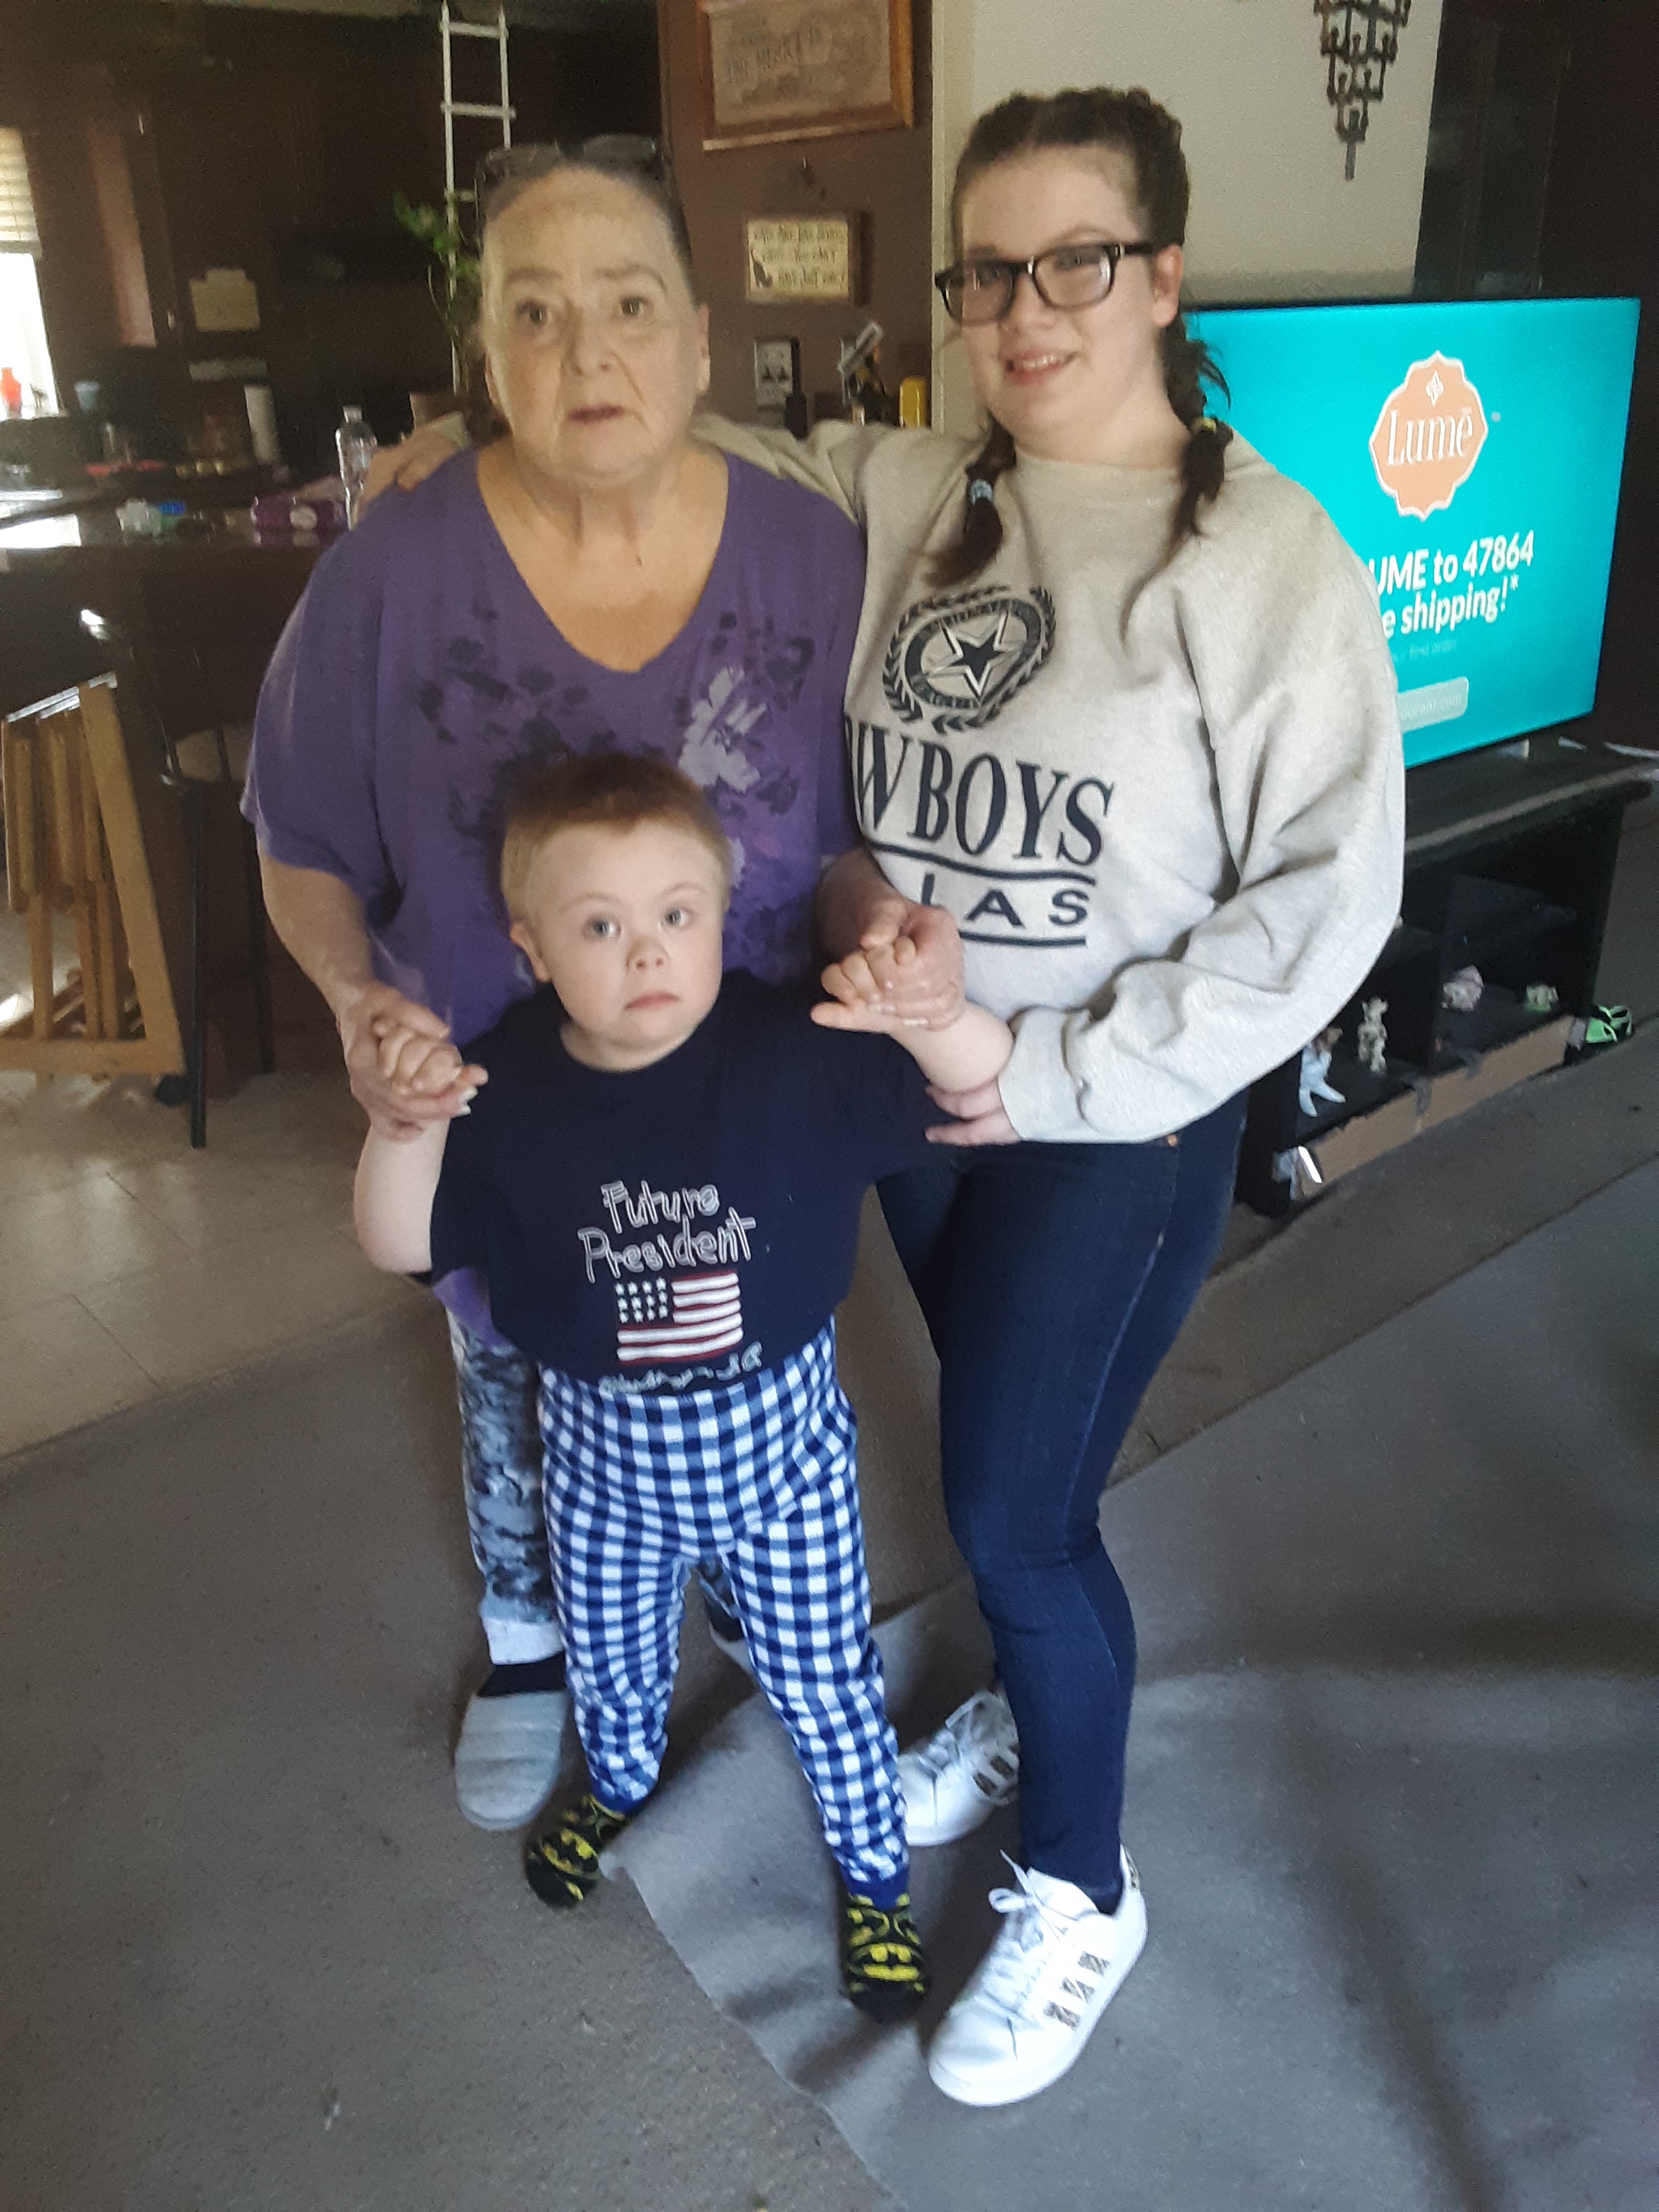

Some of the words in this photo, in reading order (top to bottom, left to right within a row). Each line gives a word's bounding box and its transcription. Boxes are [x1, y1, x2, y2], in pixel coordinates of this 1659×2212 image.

[1433, 548, 1458, 586] to
[1462, 529, 1534, 577] 47864
[844, 716, 1114, 866] WBOYS
[600, 1180, 720, 1234] Future
[577, 1206, 757, 1284] President
